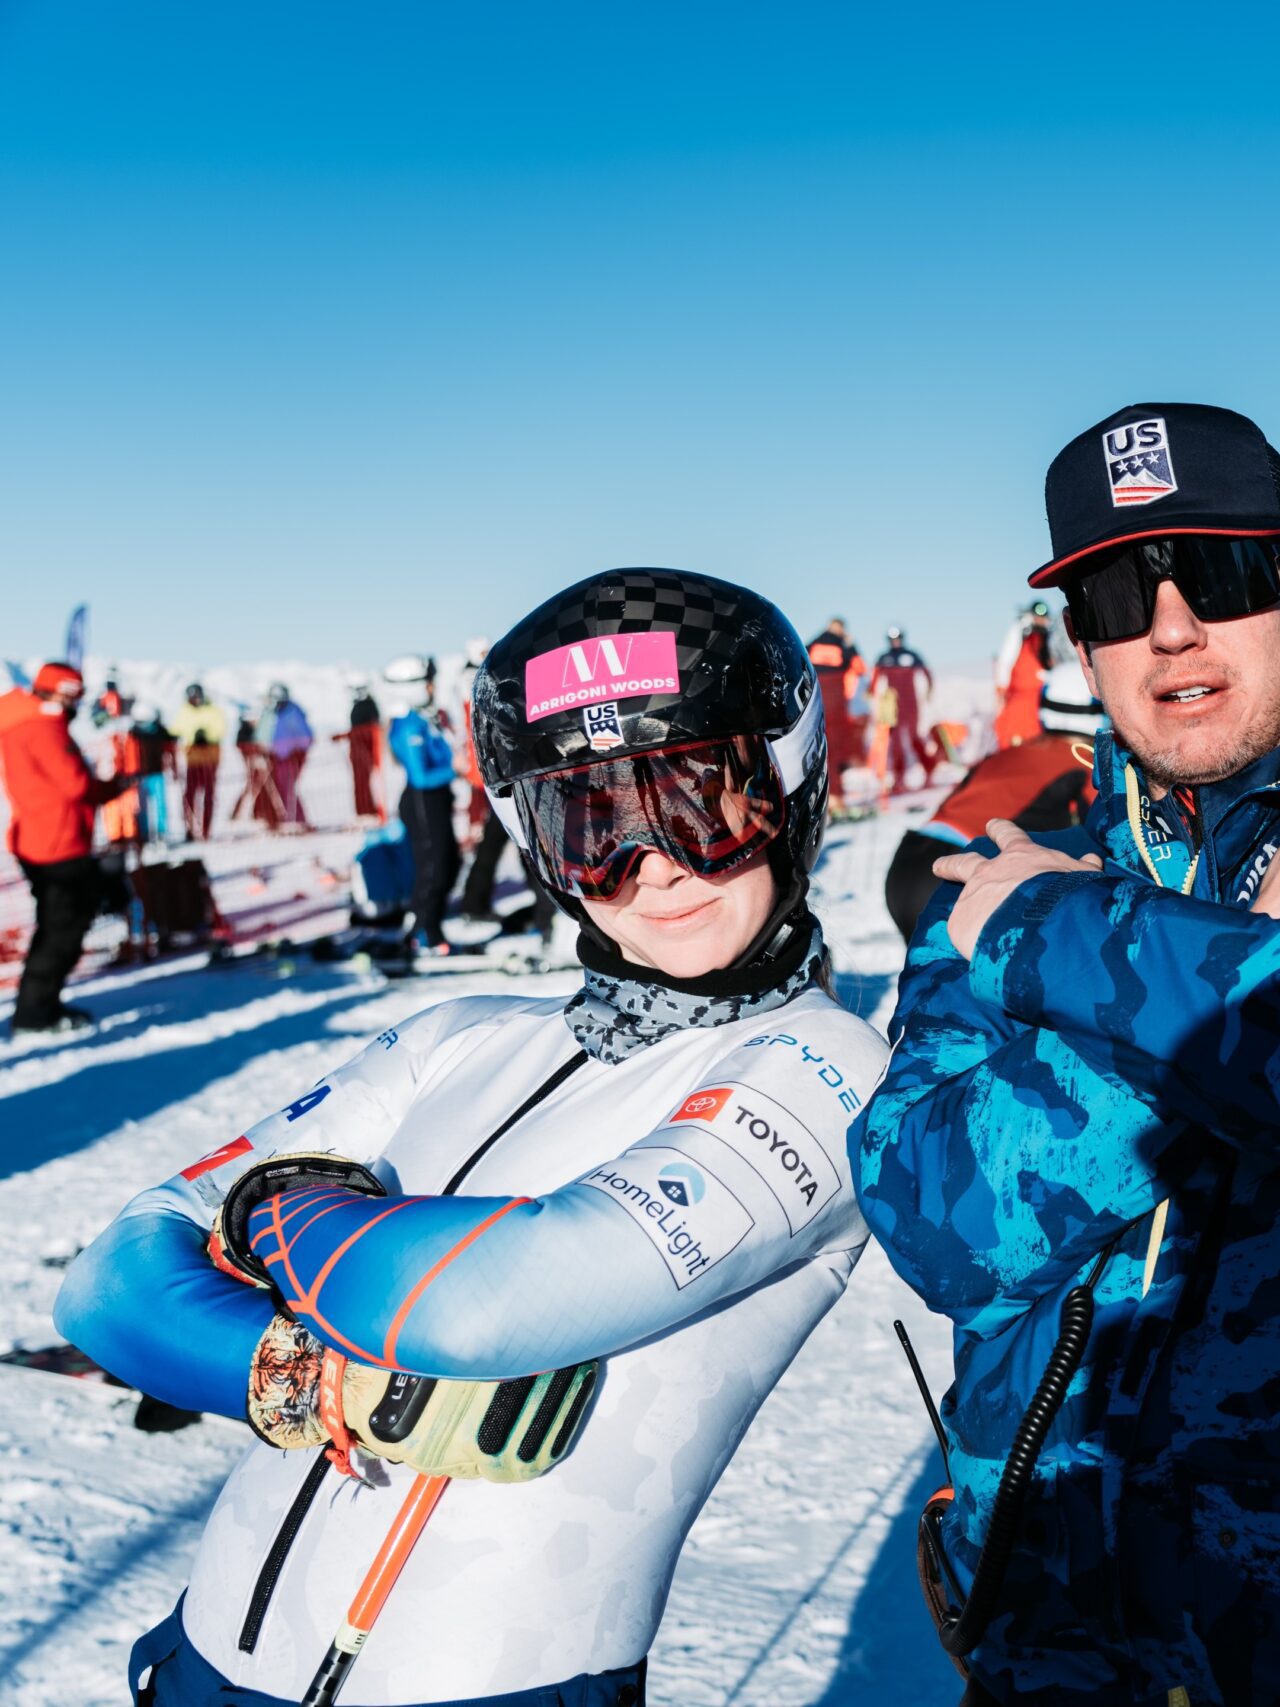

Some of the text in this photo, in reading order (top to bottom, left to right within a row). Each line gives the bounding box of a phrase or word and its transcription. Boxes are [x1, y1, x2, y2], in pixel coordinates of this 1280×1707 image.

[1107, 422, 1162, 457] US
[529, 677, 676, 716] ARRIGONI WOODS
[587, 704, 617, 722] US
[744, 1033, 862, 1113] SPYDE
[734, 1105, 819, 1207] TOYOTA
[589, 1170, 712, 1276] HomeLight
[323, 1358, 339, 1430] EKI
[391, 1373, 409, 1400] LE
